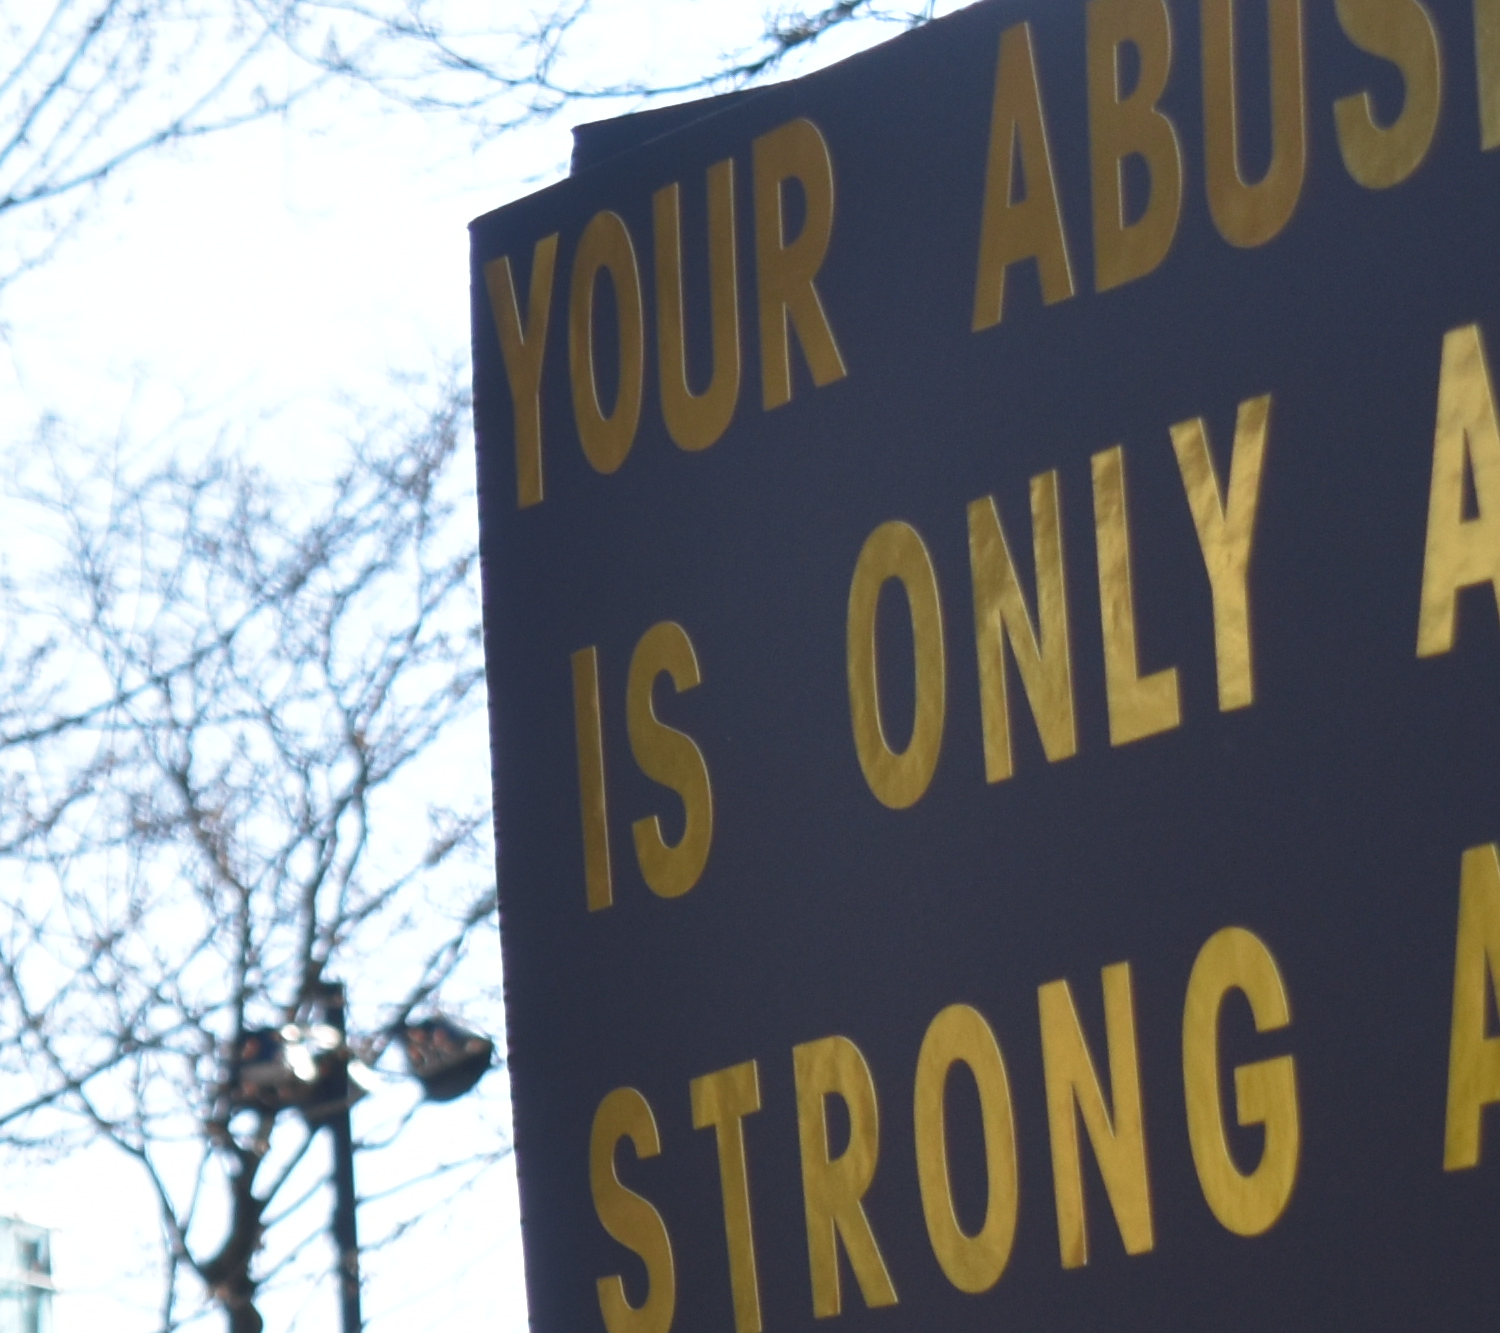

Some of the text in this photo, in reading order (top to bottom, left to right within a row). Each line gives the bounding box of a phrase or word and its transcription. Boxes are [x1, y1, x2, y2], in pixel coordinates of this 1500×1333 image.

[486, 0, 1500, 510] YOUR ABUS
[574, 620, 715, 912] IS
[847, 394, 1272, 811] ONLY
